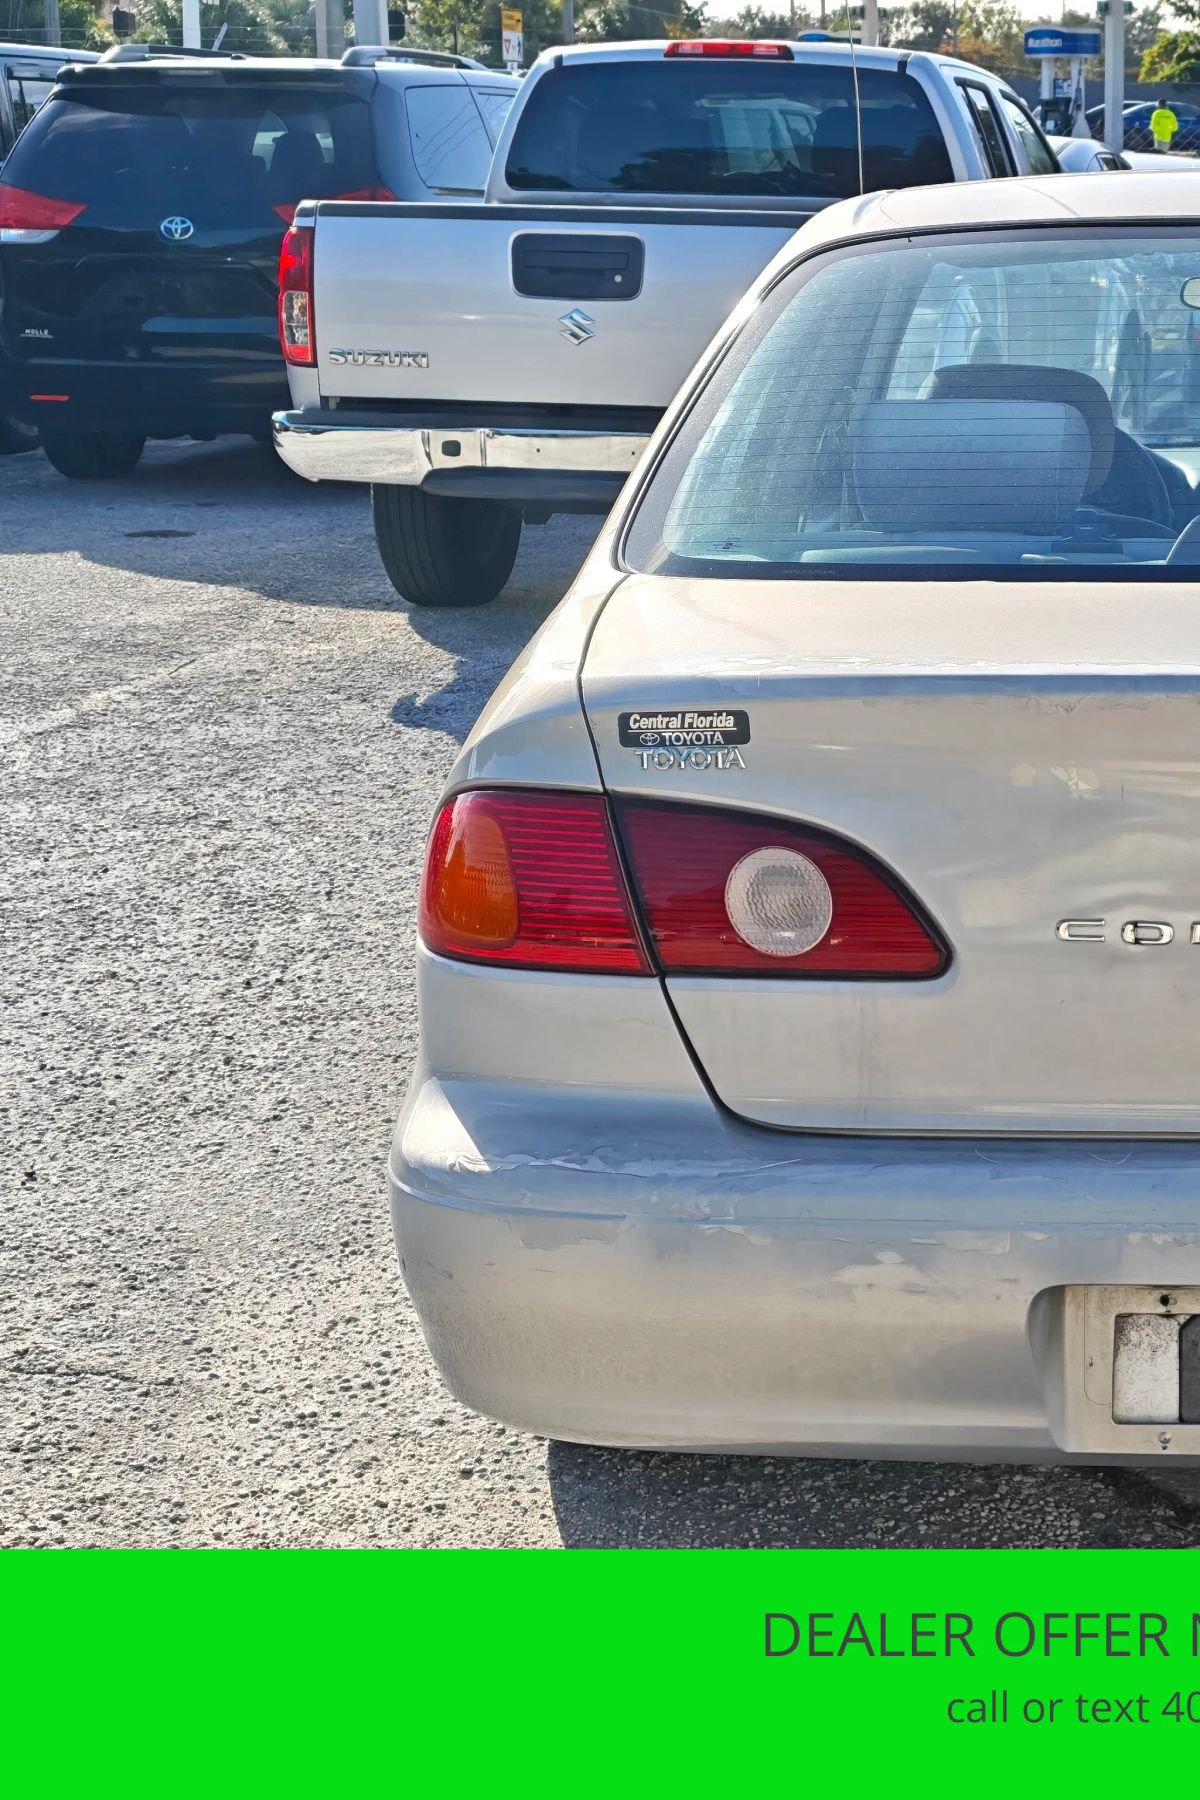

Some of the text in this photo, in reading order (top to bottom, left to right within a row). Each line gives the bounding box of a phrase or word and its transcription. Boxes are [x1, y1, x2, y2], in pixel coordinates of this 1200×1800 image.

[328, 348, 429, 369] SUZUKI
[629, 712, 734, 729] Central Florida
[661, 731, 724, 746] TOYOTA
[634, 747, 747, 770] TOYOTA
